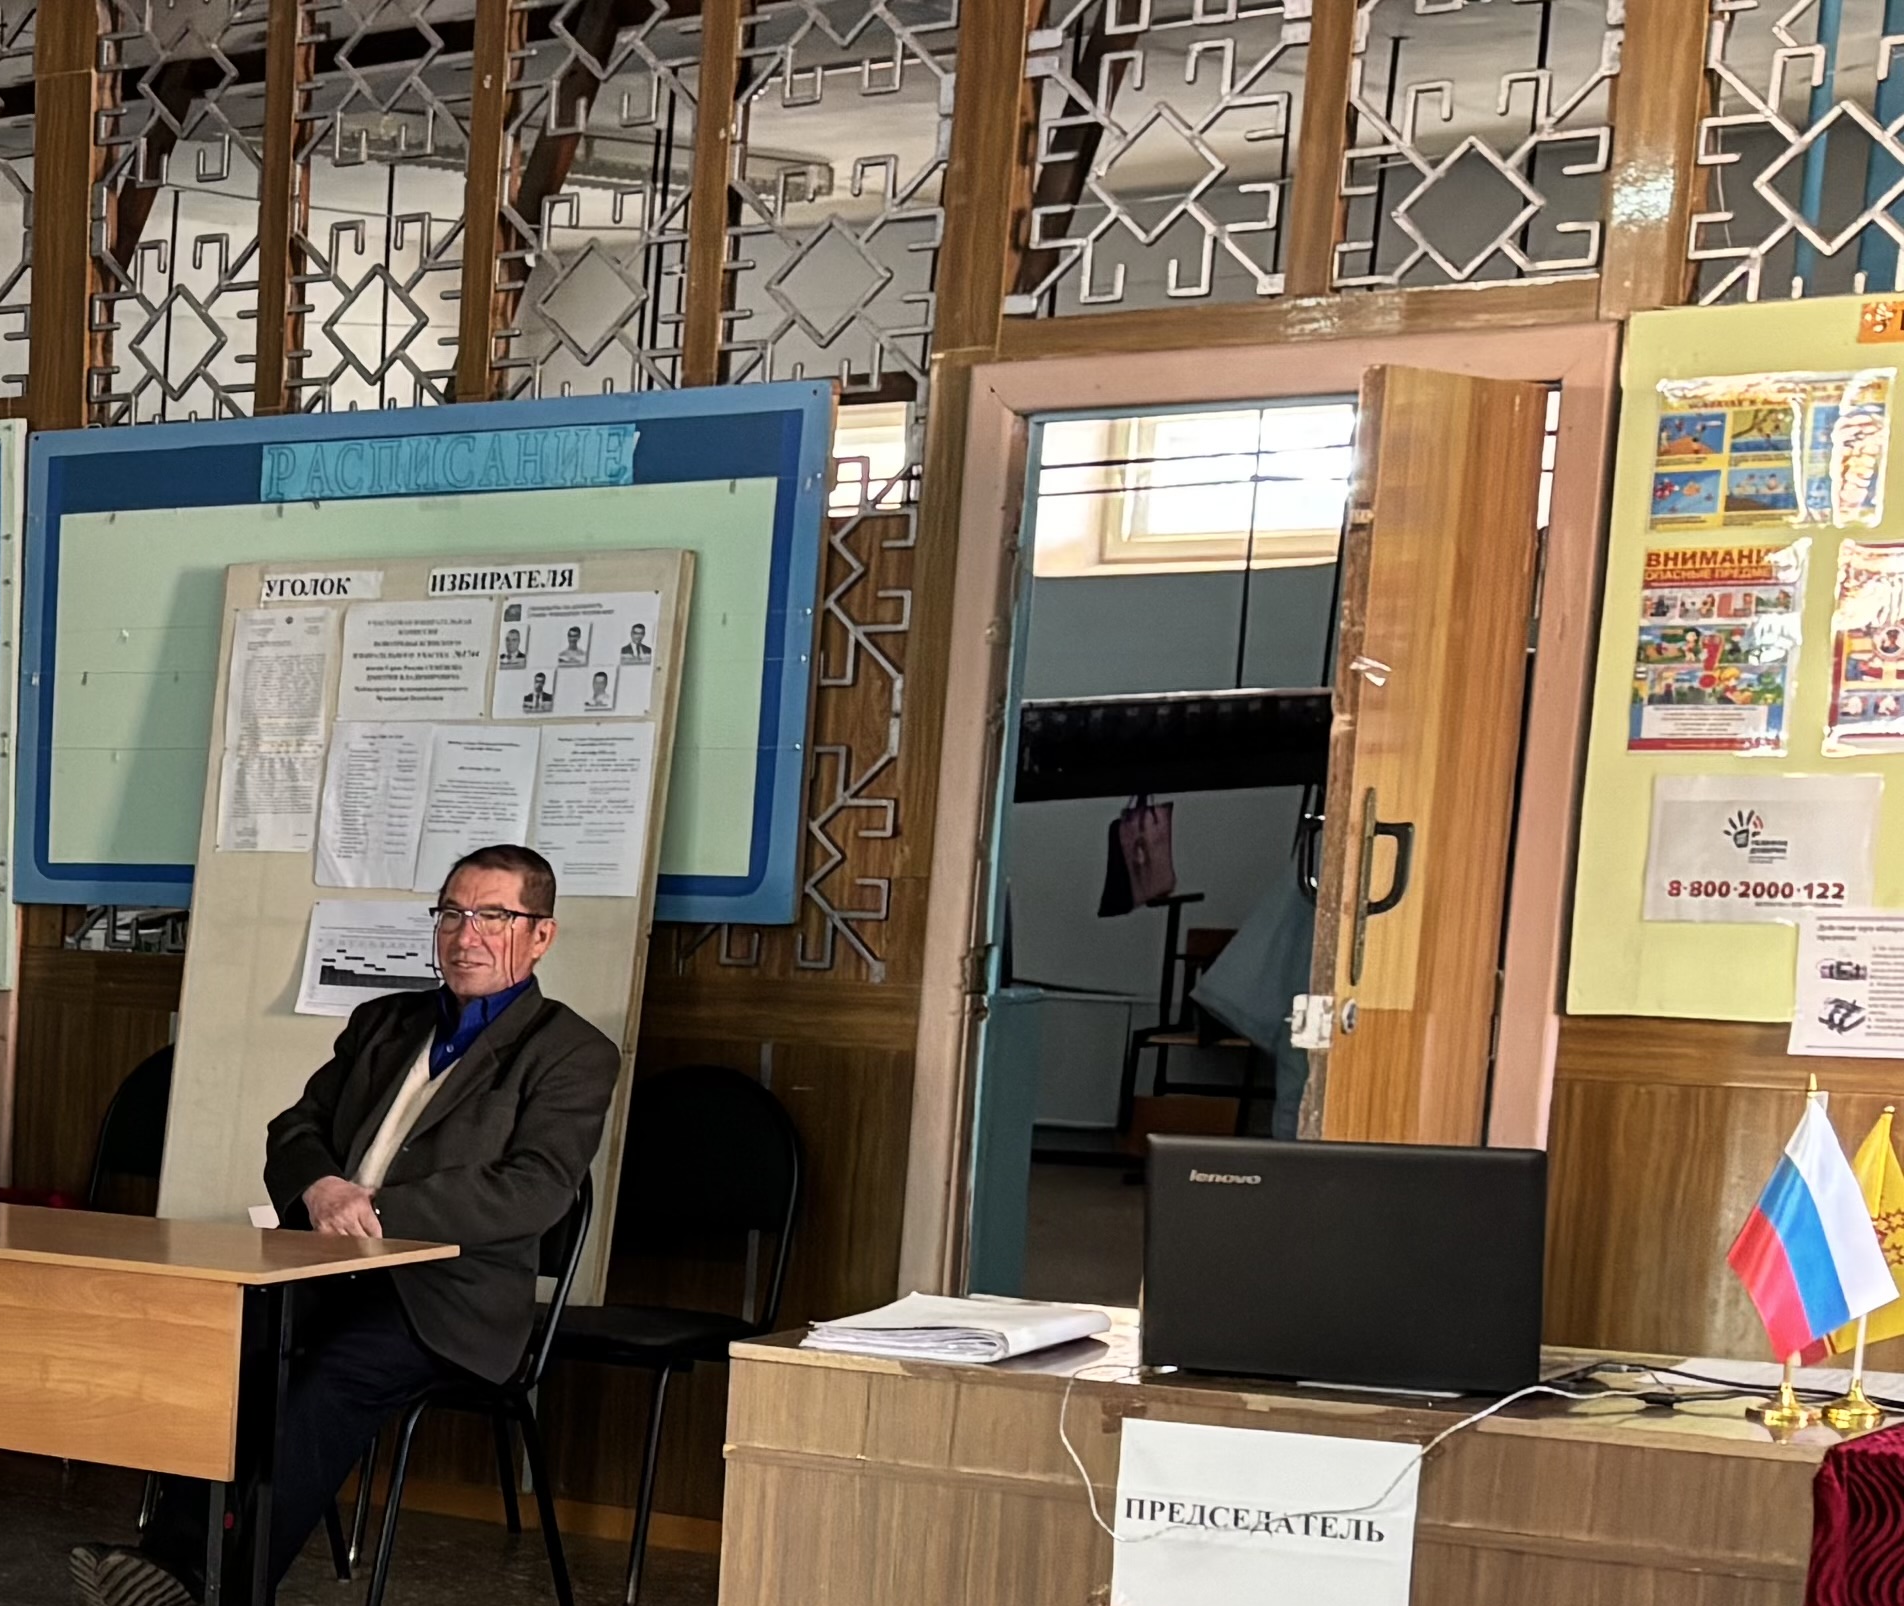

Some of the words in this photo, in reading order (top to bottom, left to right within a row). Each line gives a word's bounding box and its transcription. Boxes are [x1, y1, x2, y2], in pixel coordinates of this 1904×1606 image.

[265, 577, 352, 598] УГОЛОК
[430, 568, 575, 593] ИЗБИРАТЕЛЯ
[1125, 1498, 1386, 1544] ПРЕДСЕДАТЕЛЬ
